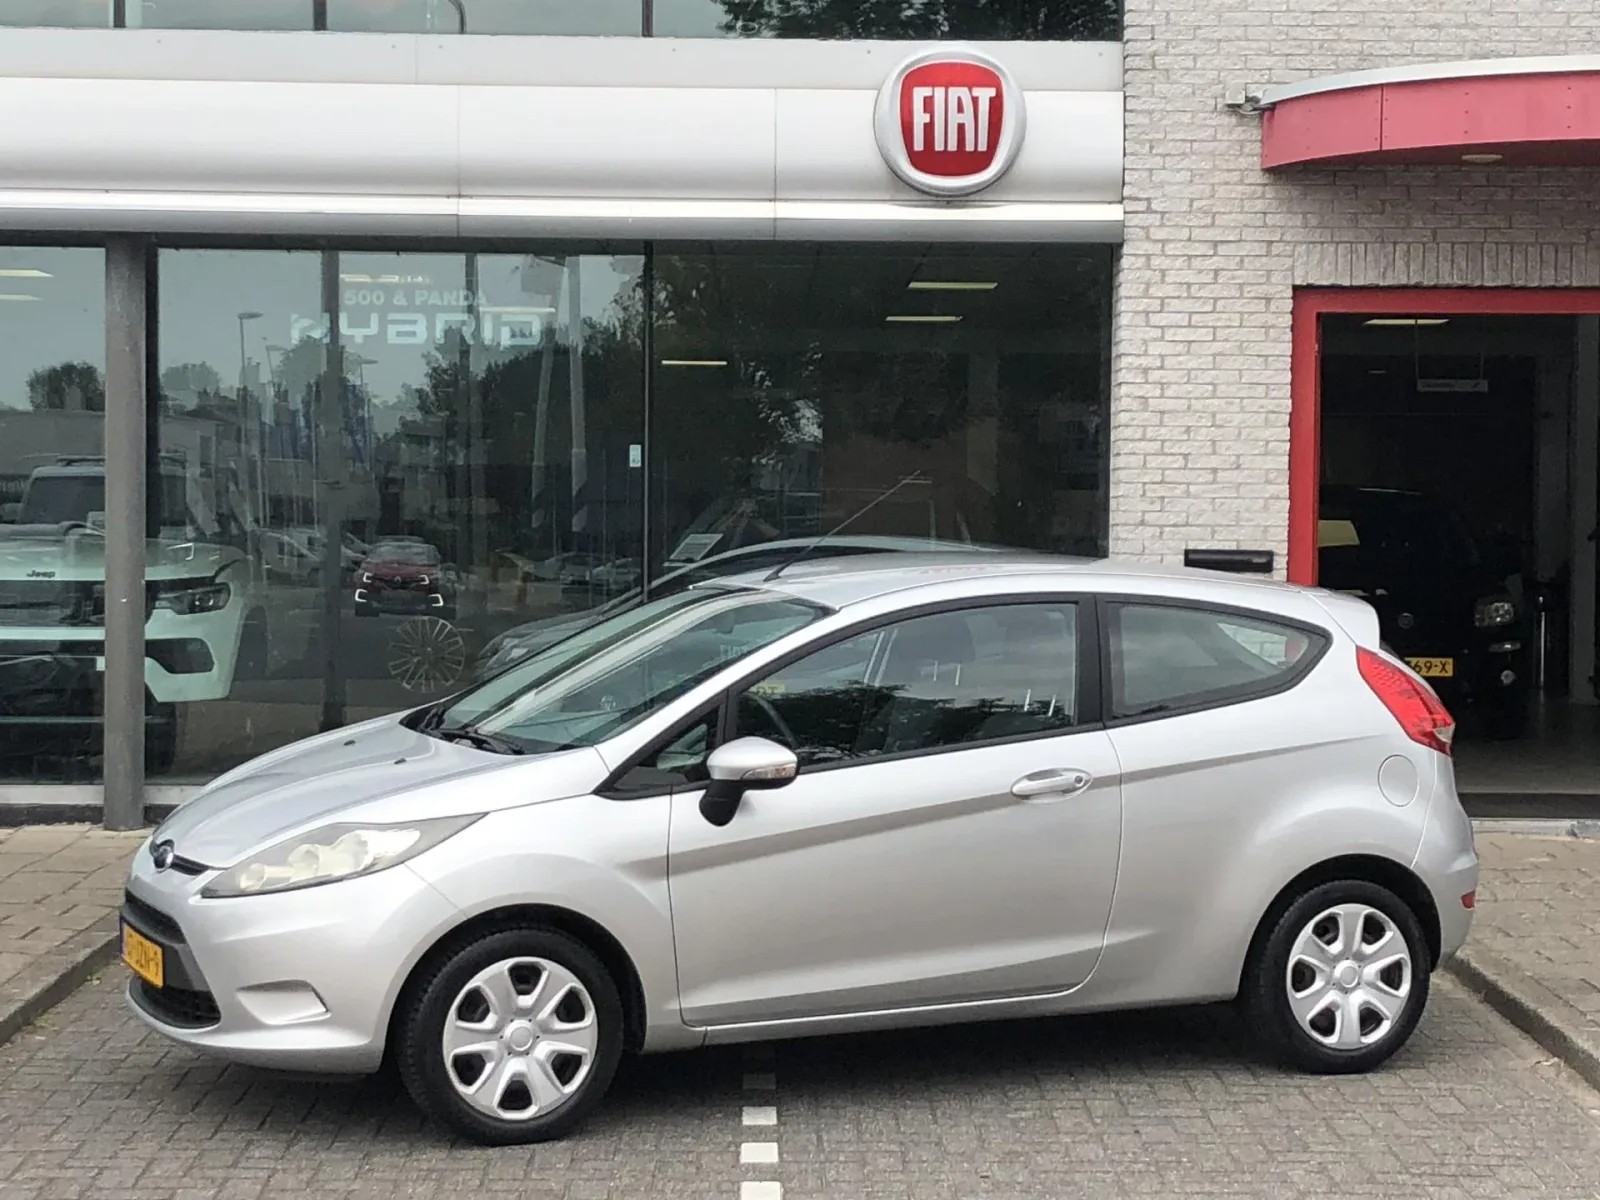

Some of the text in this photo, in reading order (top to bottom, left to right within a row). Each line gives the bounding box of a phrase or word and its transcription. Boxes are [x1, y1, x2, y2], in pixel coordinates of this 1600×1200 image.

[913, 86, 997, 152] FIAT
[343, 289, 489, 306] 500 & PANDA
[26, 569, 56, 579] Jeep
[1406, 659, 1449, 674] 69-X
